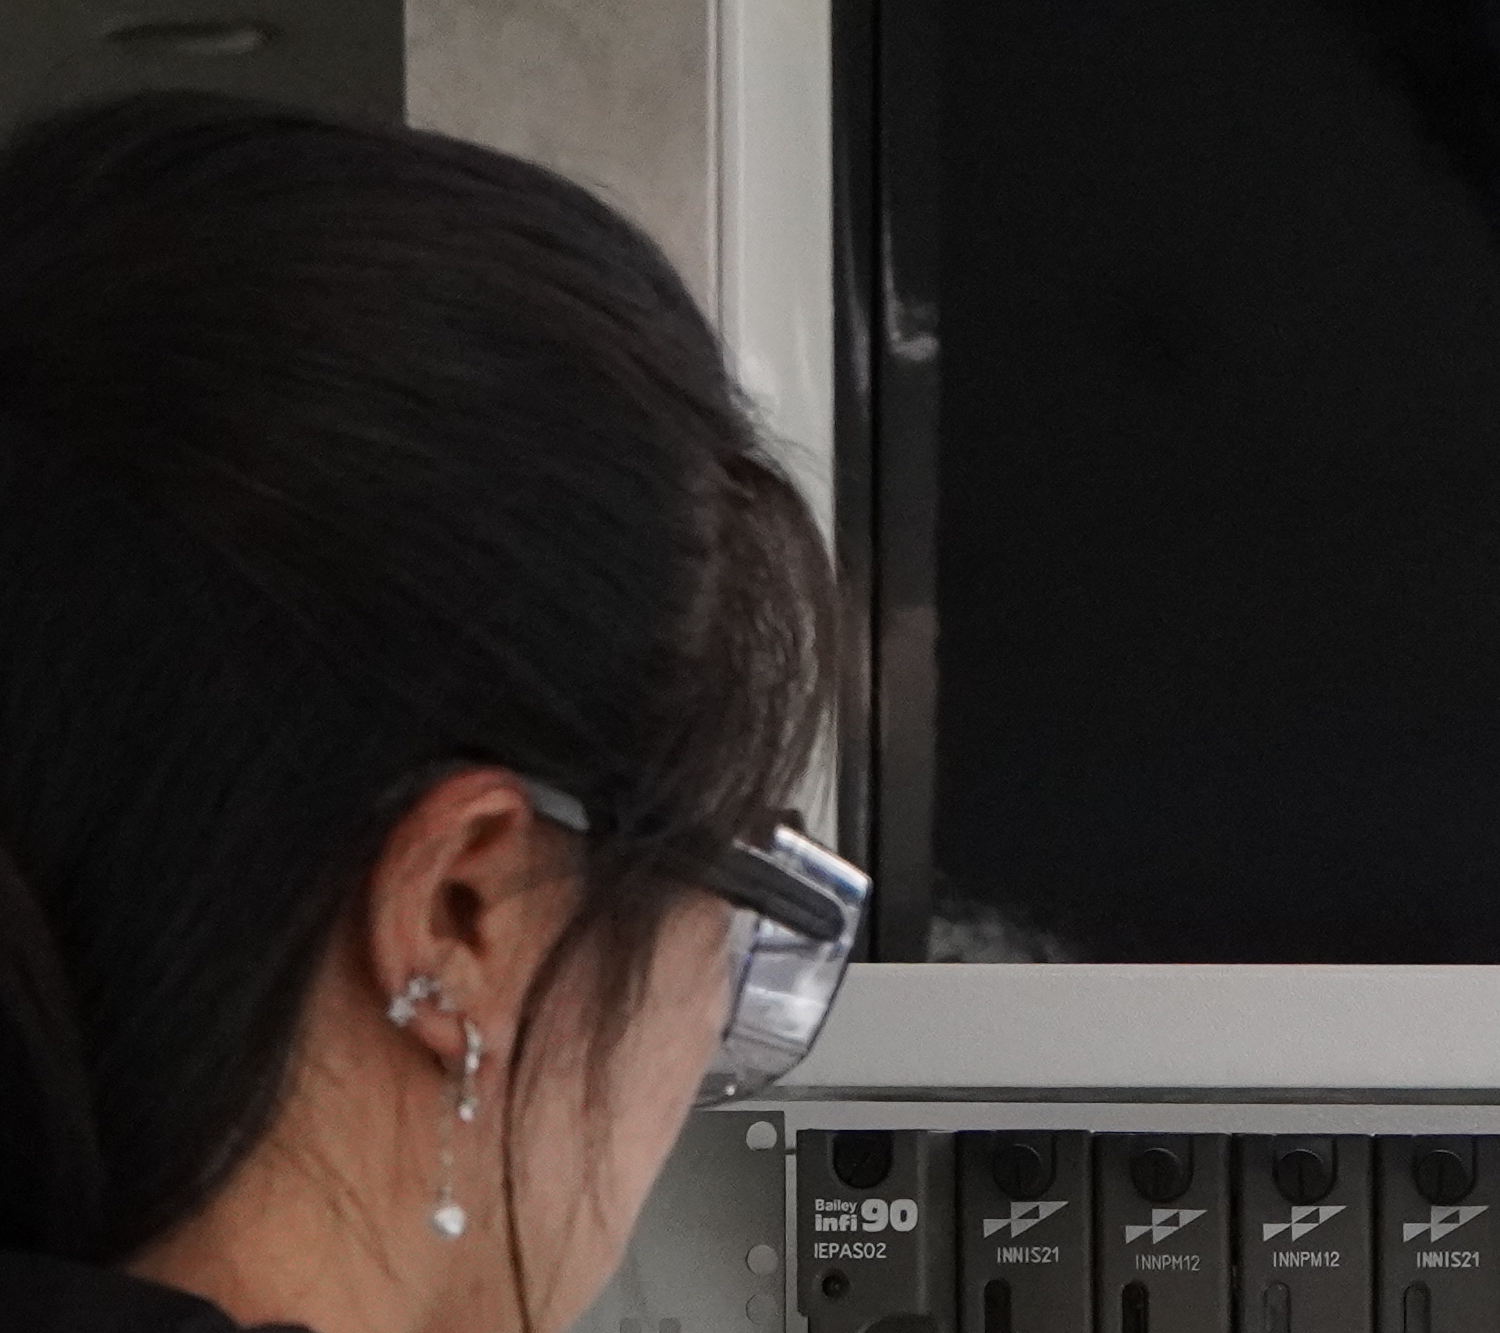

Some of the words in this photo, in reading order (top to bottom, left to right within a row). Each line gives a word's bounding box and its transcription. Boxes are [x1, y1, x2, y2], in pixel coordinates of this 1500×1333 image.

[815, 1198, 857, 1214] Bailey
[815, 1214, 857, 1231] infi
[860, 1197, 919, 1233] 90
[997, 1246, 1059, 1264] INNIS21
[1135, 1254, 1200, 1272] INNPM12
[1273, 1250, 1340, 1268] INNPM12
[1416, 1251, 1480, 1268] INNIS21
